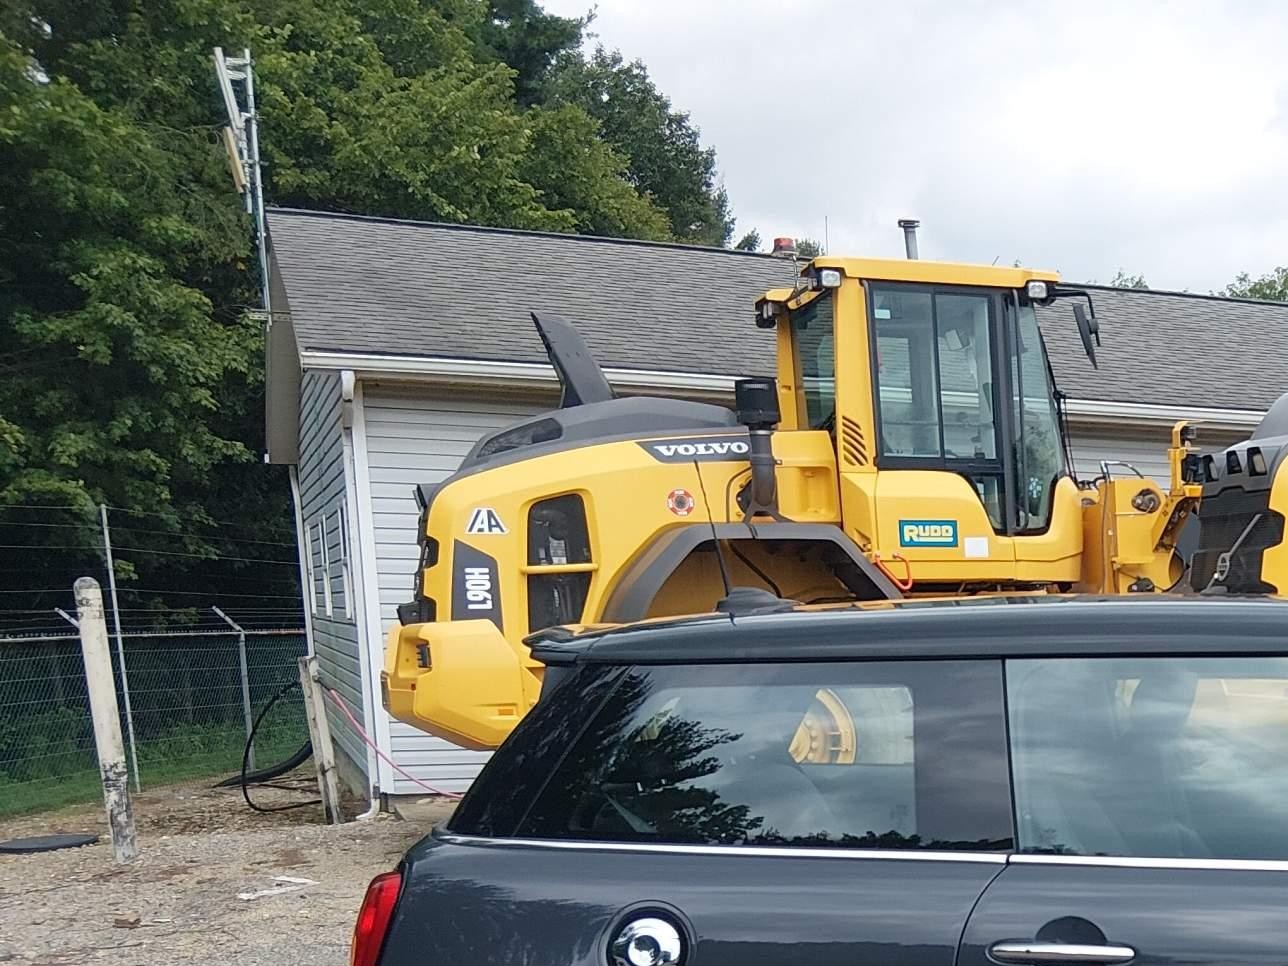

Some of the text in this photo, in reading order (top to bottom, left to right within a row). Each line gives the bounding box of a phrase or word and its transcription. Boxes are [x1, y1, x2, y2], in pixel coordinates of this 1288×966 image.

[654, 441, 749, 457] VOLVO
[903, 524, 954, 543] RUDD
[464, 567, 493, 610] L90H
